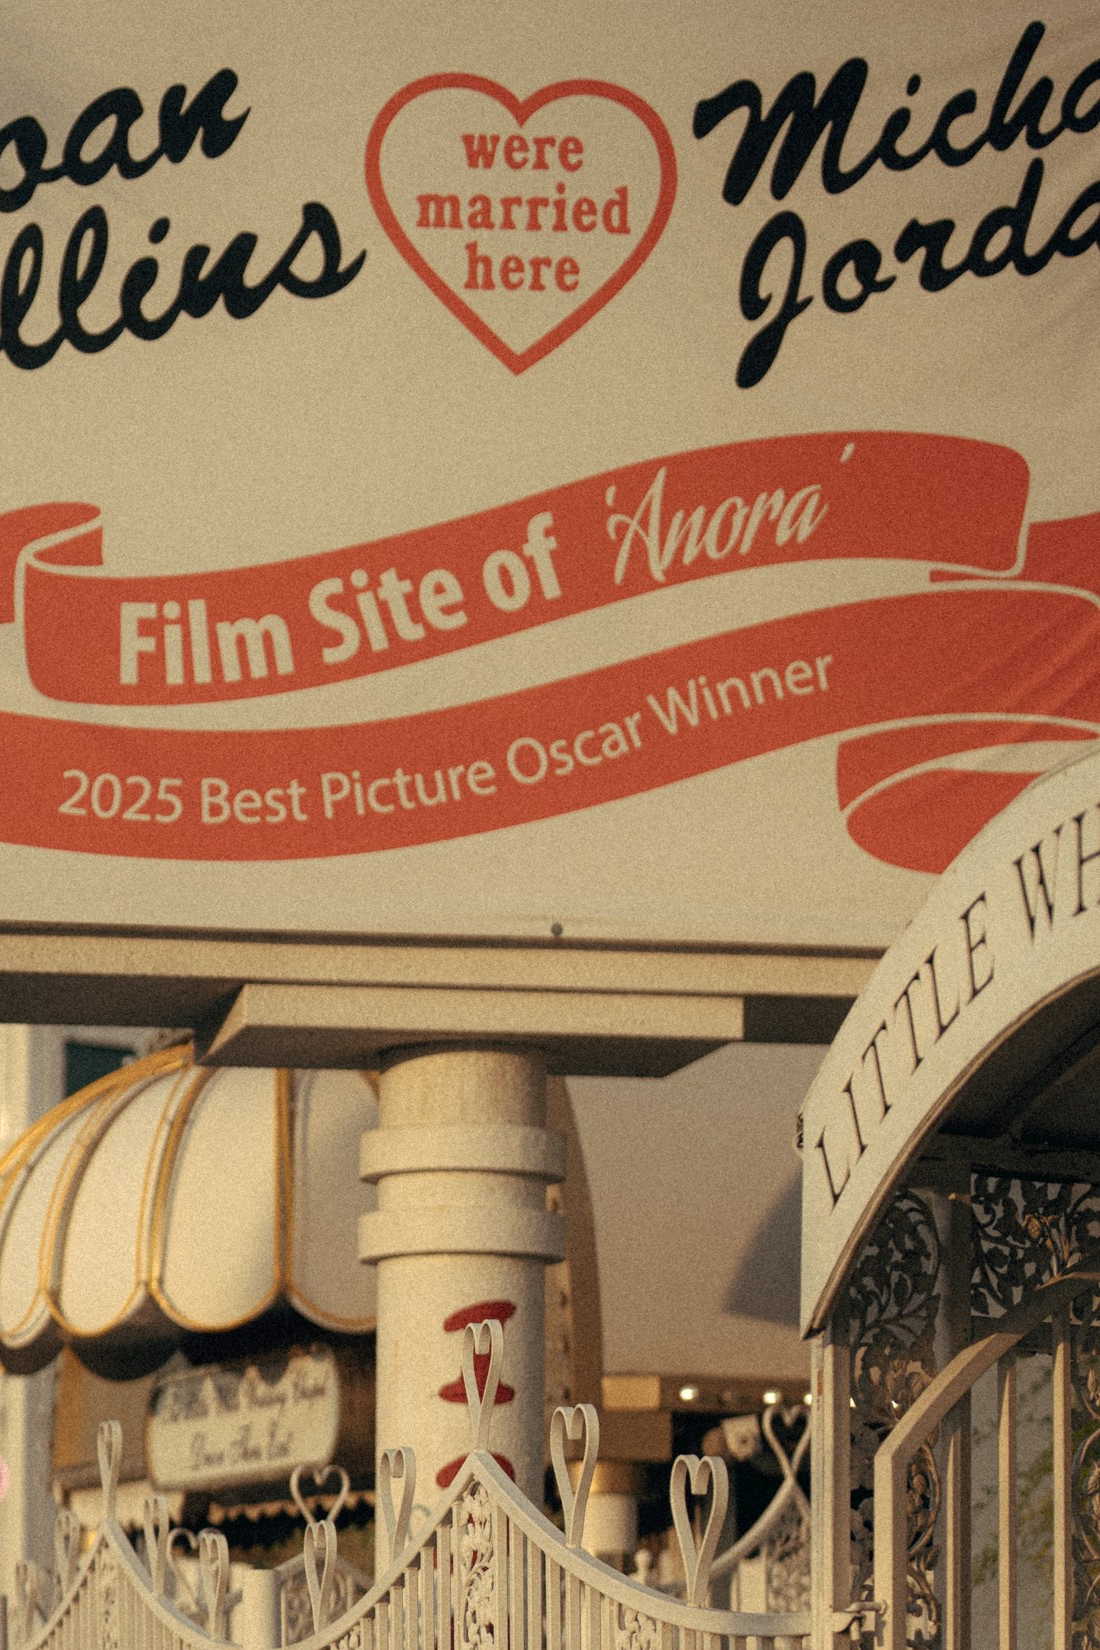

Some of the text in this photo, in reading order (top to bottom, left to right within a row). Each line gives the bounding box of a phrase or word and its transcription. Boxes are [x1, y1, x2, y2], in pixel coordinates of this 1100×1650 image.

[461, 132, 585, 172] were
[416, 185, 631, 236] married
[464, 241, 580, 292] here
[119, 598, 295, 685] Film
[308, 566, 468, 665] Site
[482, 511, 562, 613] of
[58, 654, 833, 825] 2025 Best Picture Oscar Winner
[814, 890, 996, 1216] LITTLE
